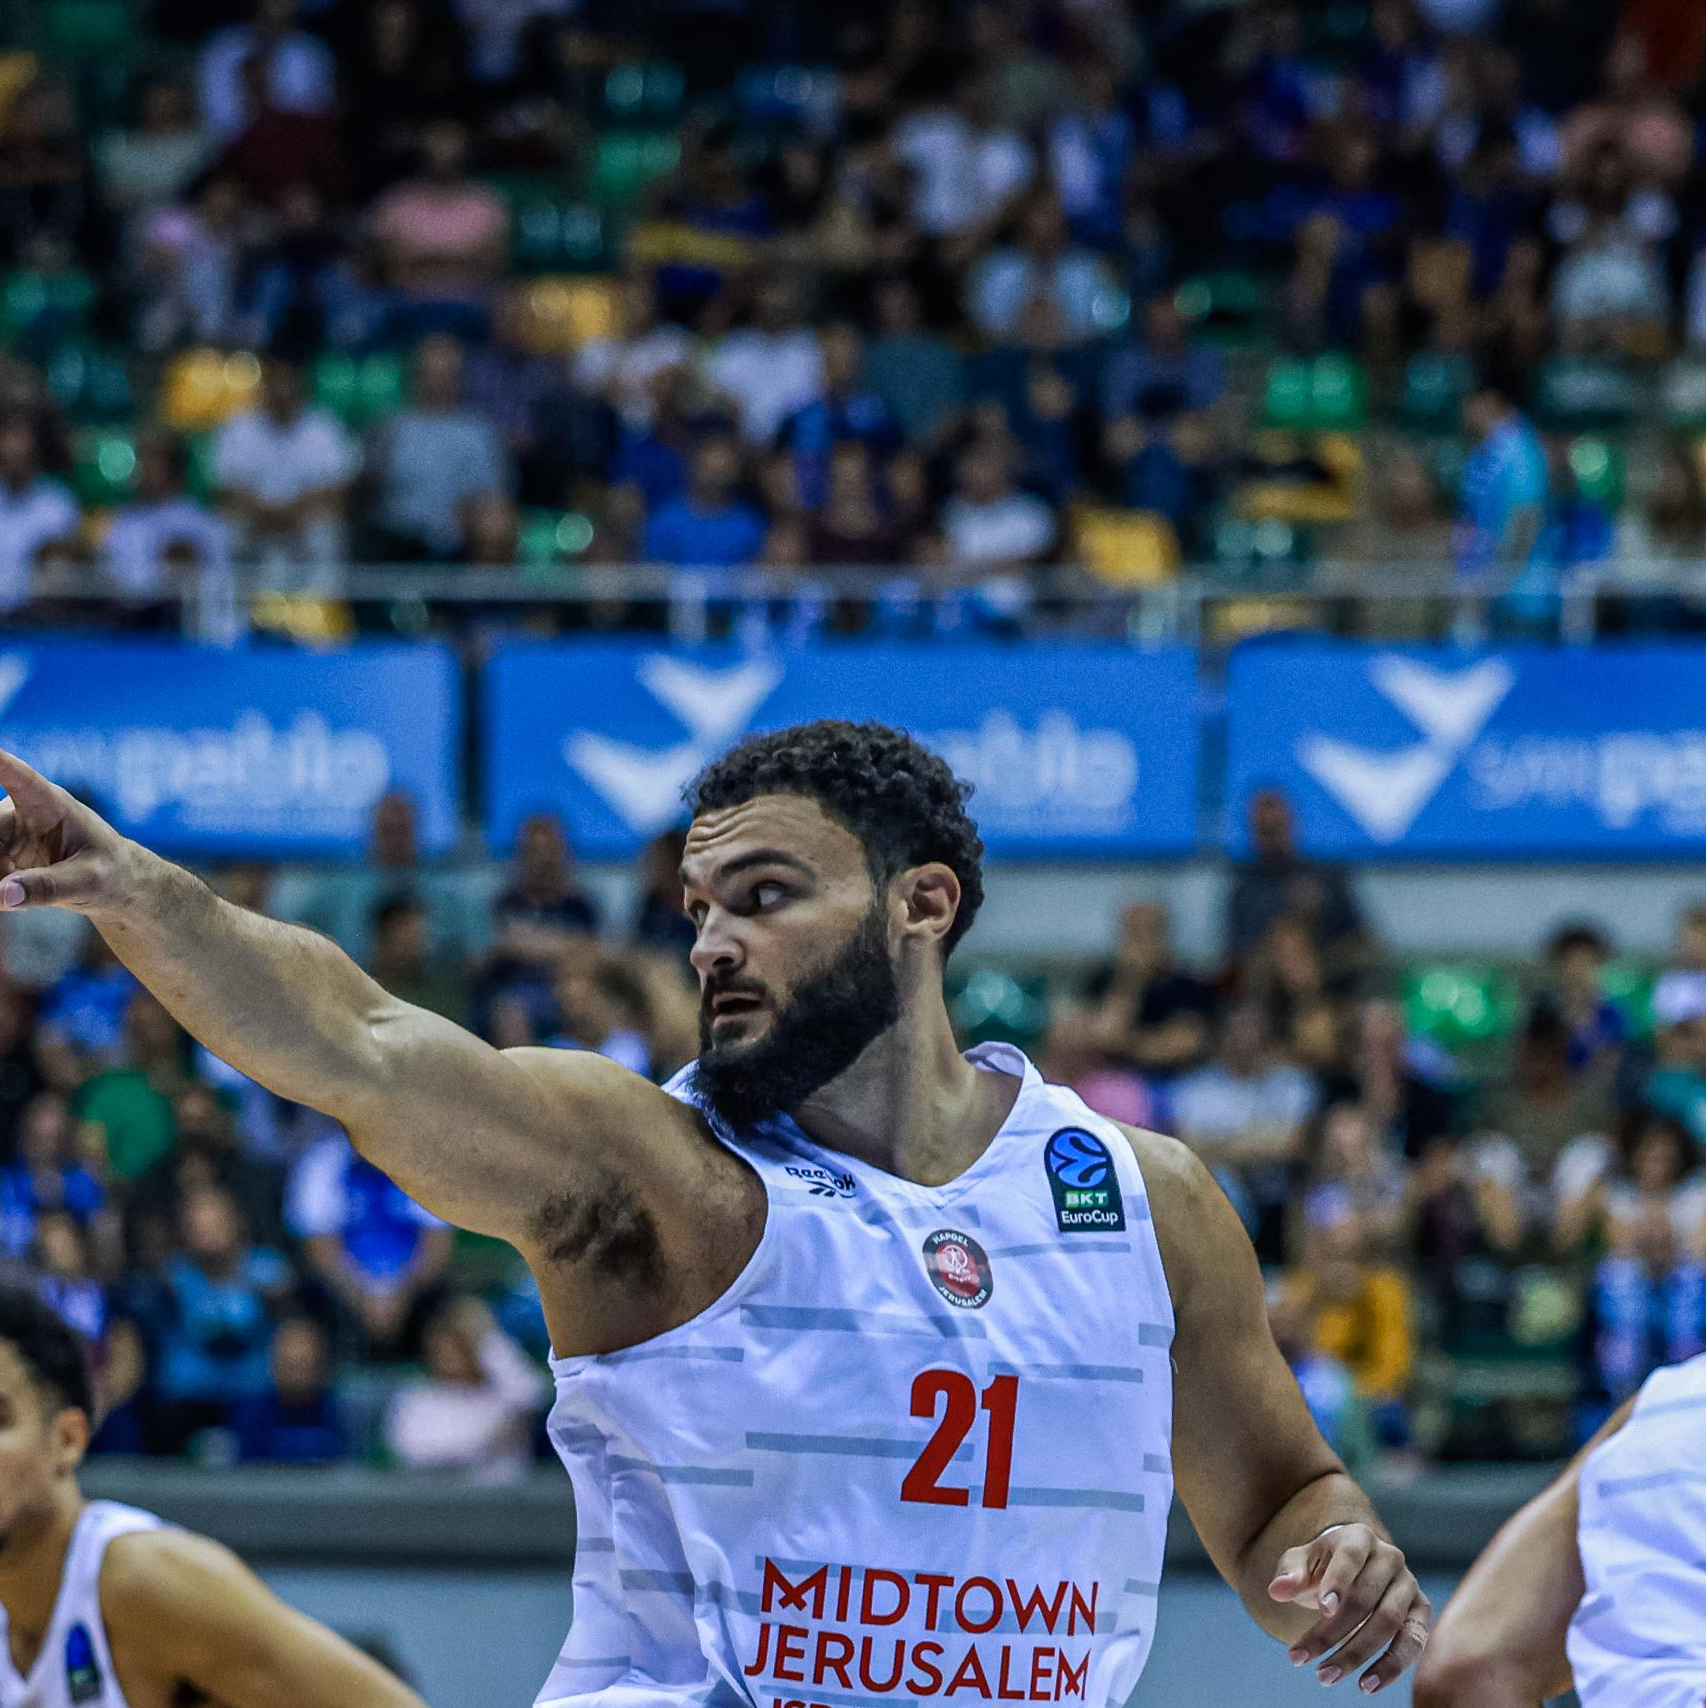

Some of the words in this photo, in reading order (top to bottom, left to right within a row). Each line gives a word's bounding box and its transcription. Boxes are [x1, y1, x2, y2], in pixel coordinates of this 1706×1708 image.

[1066, 1191, 1108, 1206] BKT
[1060, 1209, 1119, 1226] EuroCup
[933, 1231, 969, 1247] HAPOEL
[938, 1288, 988, 1307] JERUSALEM
[900, 1369, 1019, 1510] 21
[760, 1556, 1099, 1637] MIDTOWN
[743, 1622, 1092, 1702] JERUSALEM
